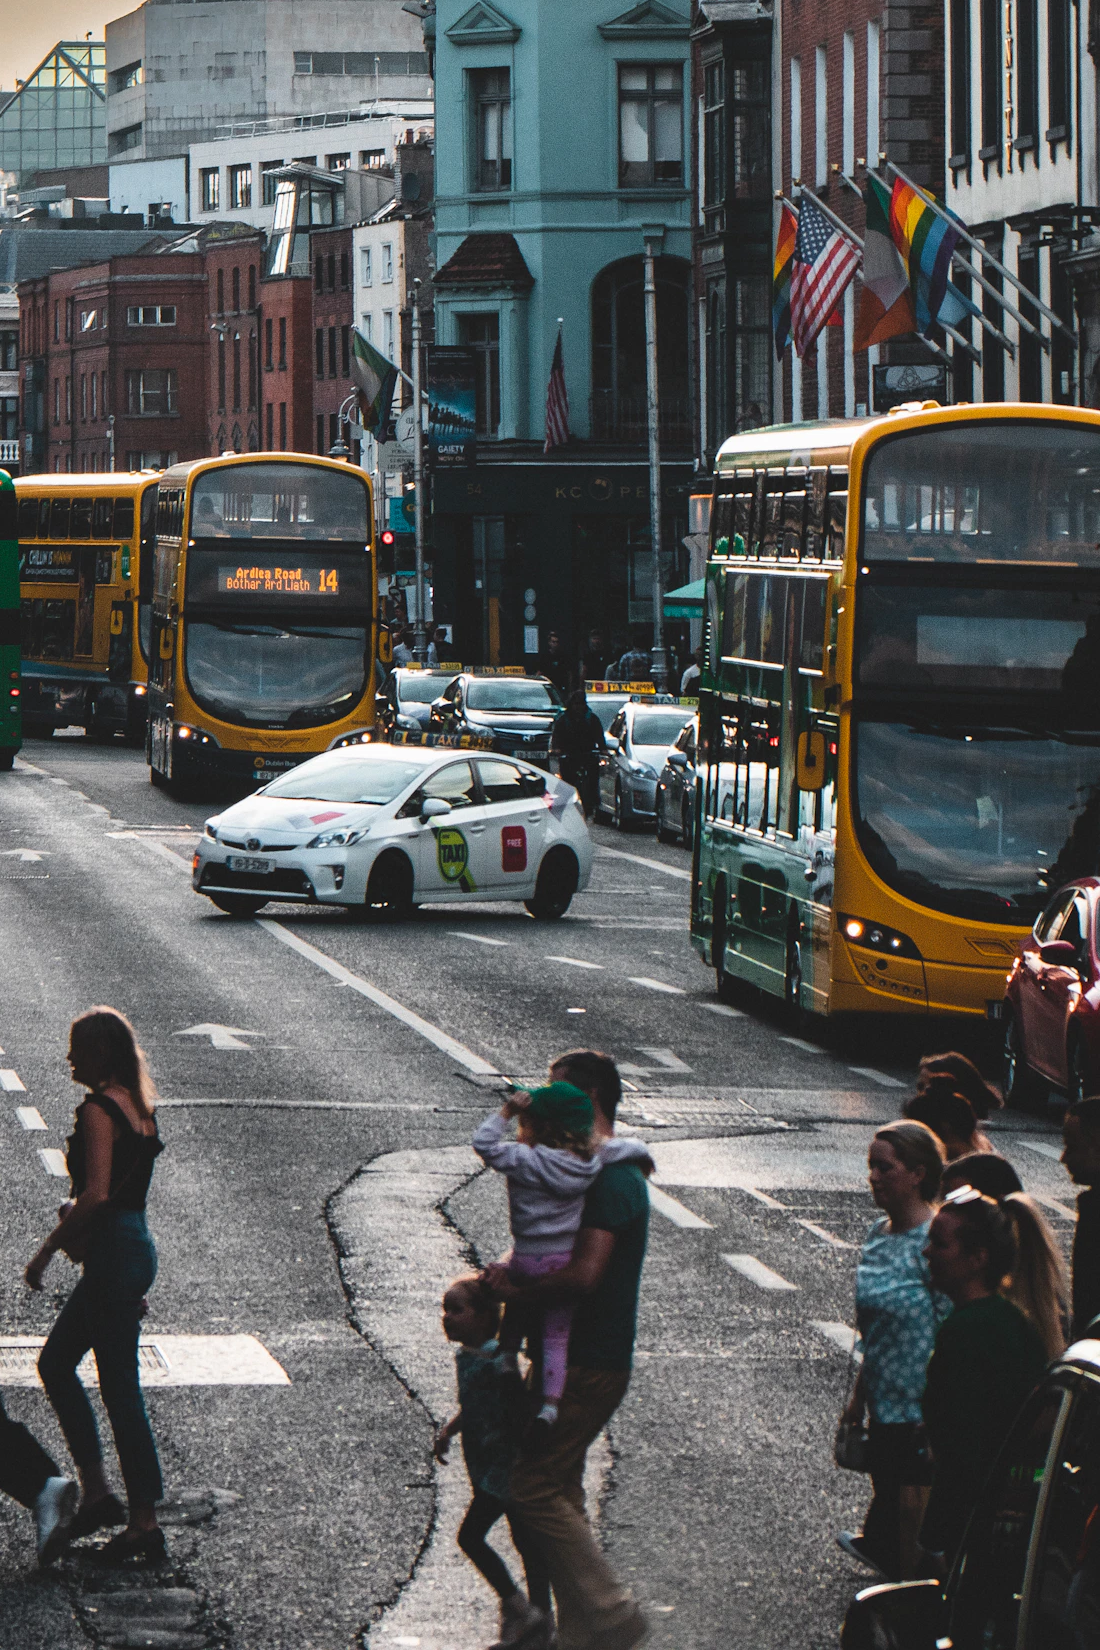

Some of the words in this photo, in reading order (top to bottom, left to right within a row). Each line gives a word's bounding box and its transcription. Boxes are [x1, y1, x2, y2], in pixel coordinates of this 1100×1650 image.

[438, 445, 465, 454] GAIETY
[467, 484, 482, 494] 54
[236, 567, 272, 579] Ardlea
[274, 567, 302, 580] Road
[265, 579, 282, 591] Ard
[285, 579, 310, 591] Liath
[319, 569, 338, 592] 14
[608, 683, 630, 691] TAXI
[432, 734, 457, 746] TAXI
[441, 844, 465, 863] TAXI
